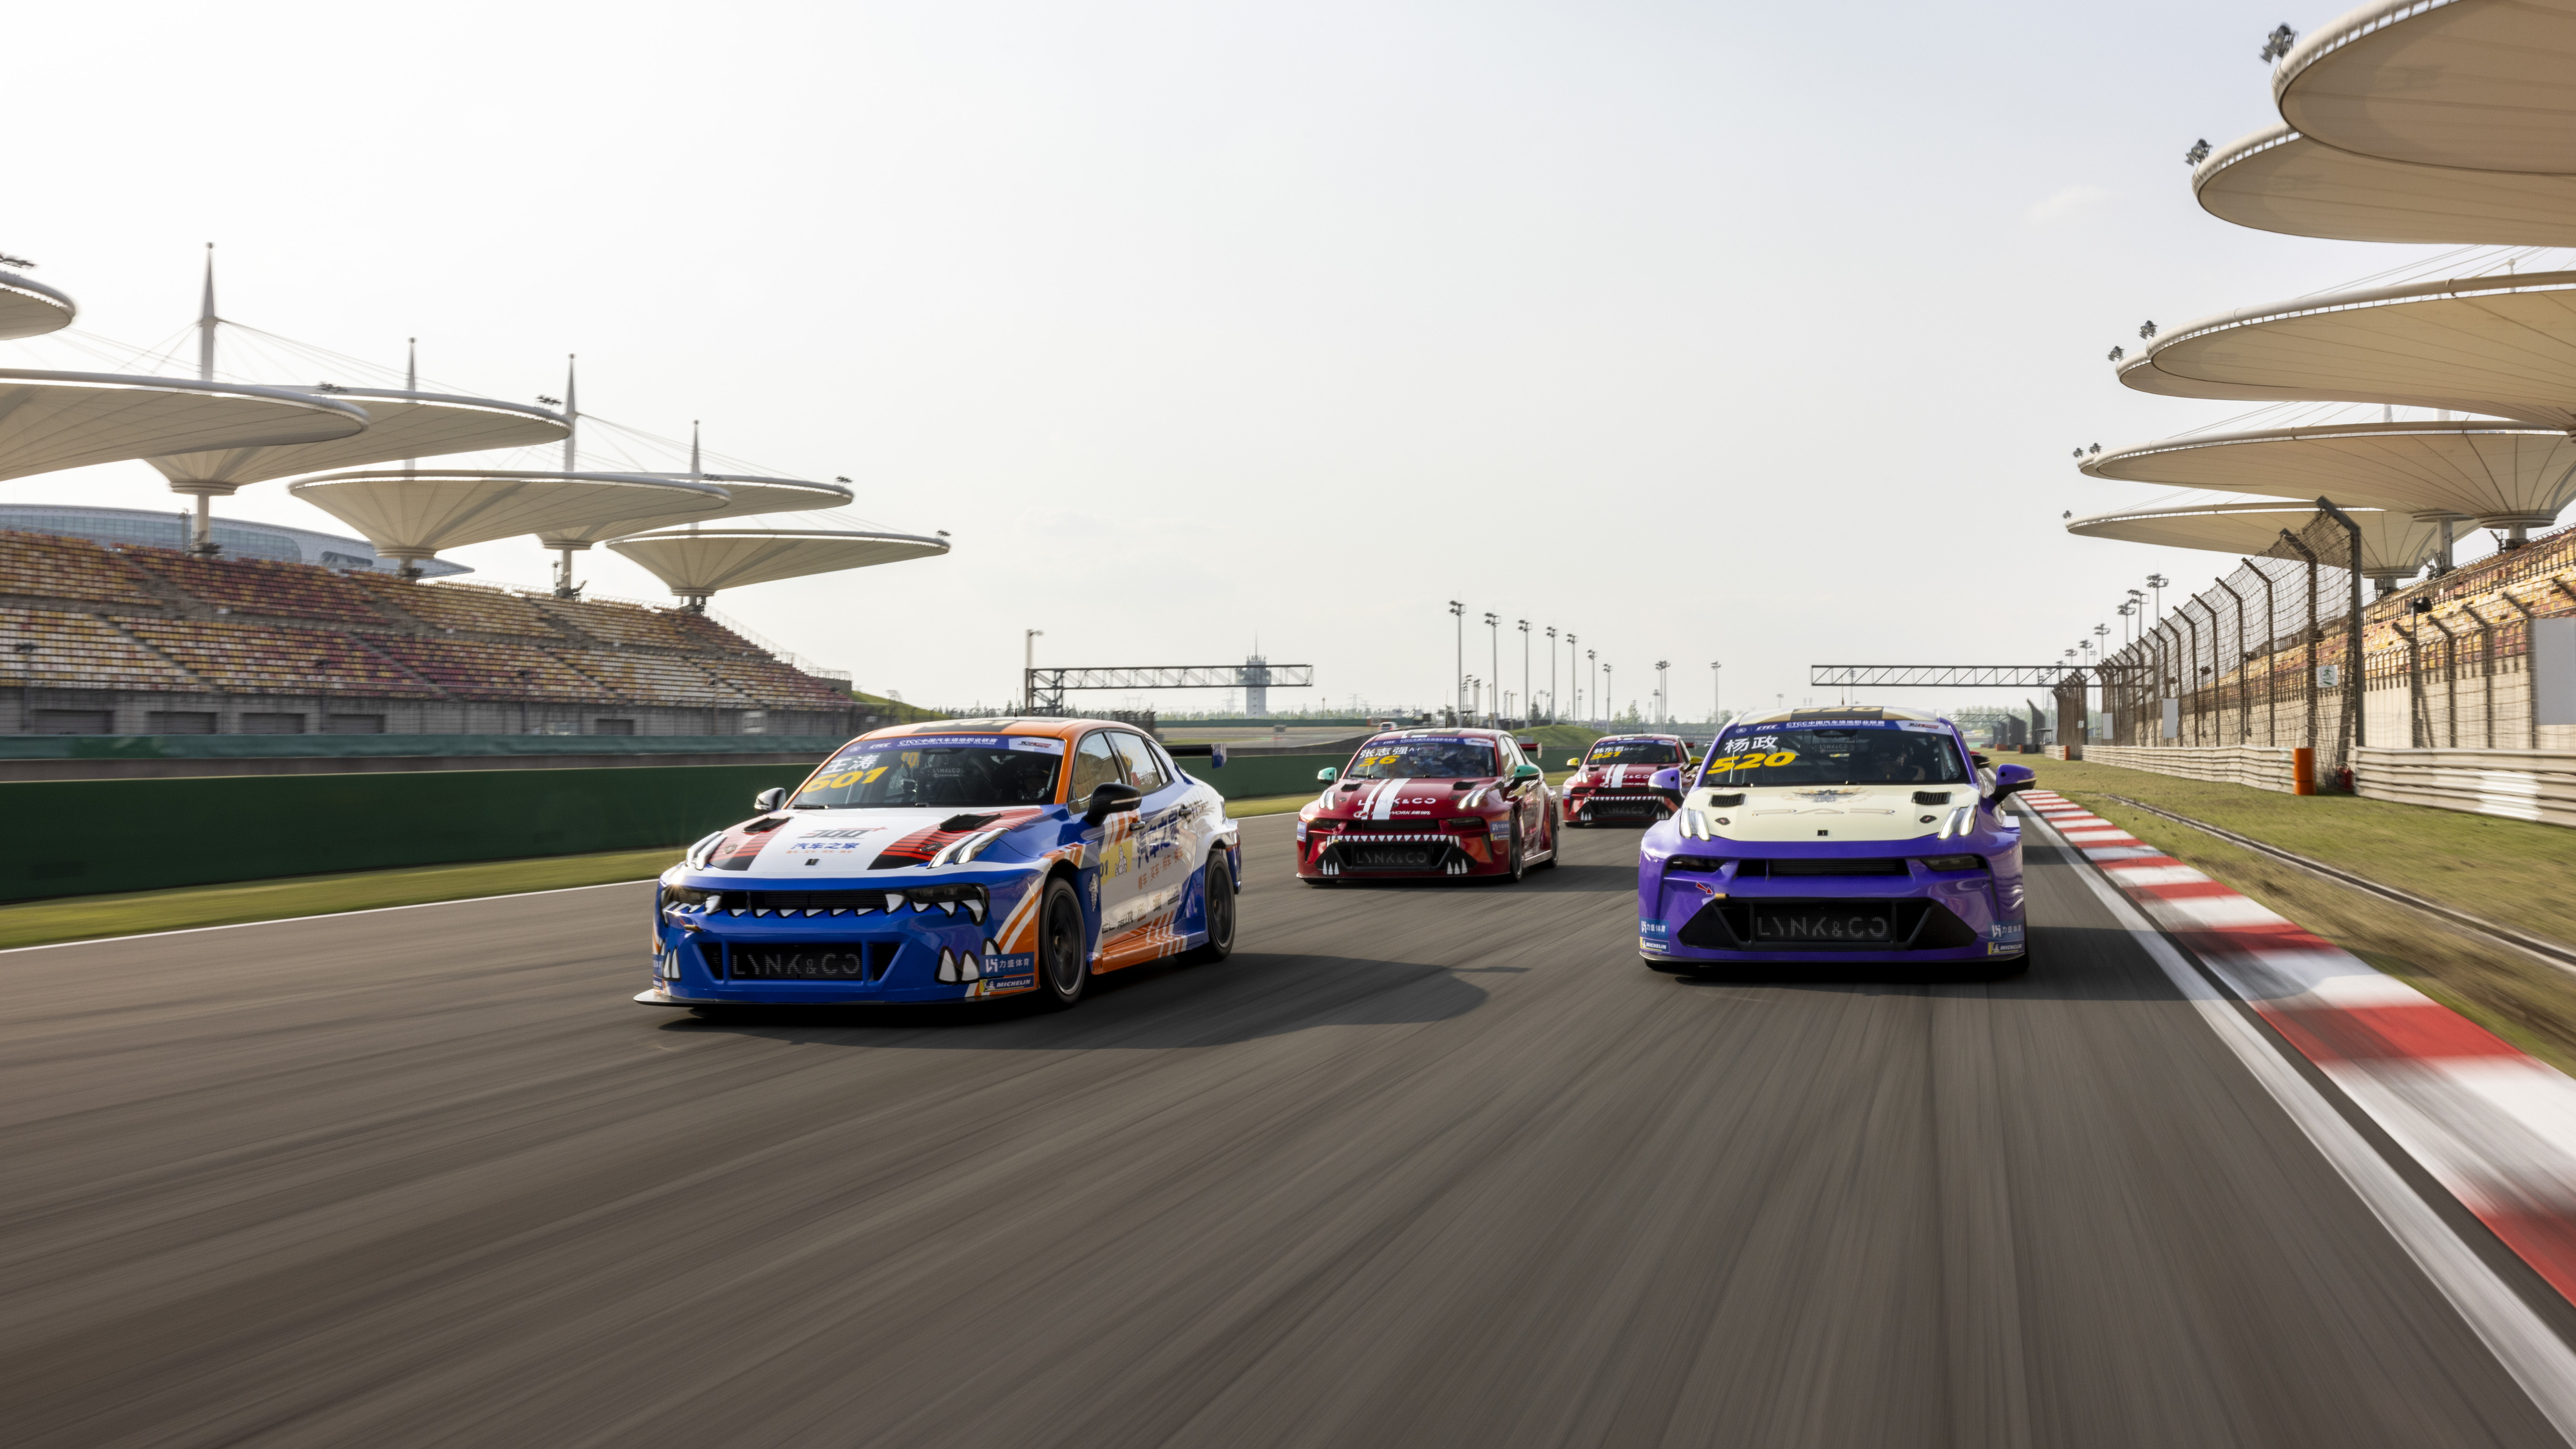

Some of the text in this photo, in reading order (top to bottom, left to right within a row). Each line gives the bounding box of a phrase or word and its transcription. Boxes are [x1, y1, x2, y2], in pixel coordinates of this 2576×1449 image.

[1724, 735, 1778, 753] 杨政
[1359, 746, 1408, 759] 张志强
[1590, 751, 1622, 760] 921
[820, 754, 881, 775] 王涛
[1358, 755, 1400, 768] 36
[1706, 752, 1796, 775] 520
[801, 766, 889, 793] 601
[1137, 808, 1180, 869] 汽车之家
[1356, 851, 1426, 864] LYNK&CO
[1647, 923, 1666, 933] 力盛体育
[1757, 916, 1888, 938] LYNK&CO
[732, 954, 860, 974] LYNK&CO
[999, 958, 1030, 968] 力盛体育
[996, 979, 1030, 988] MICHELIN
